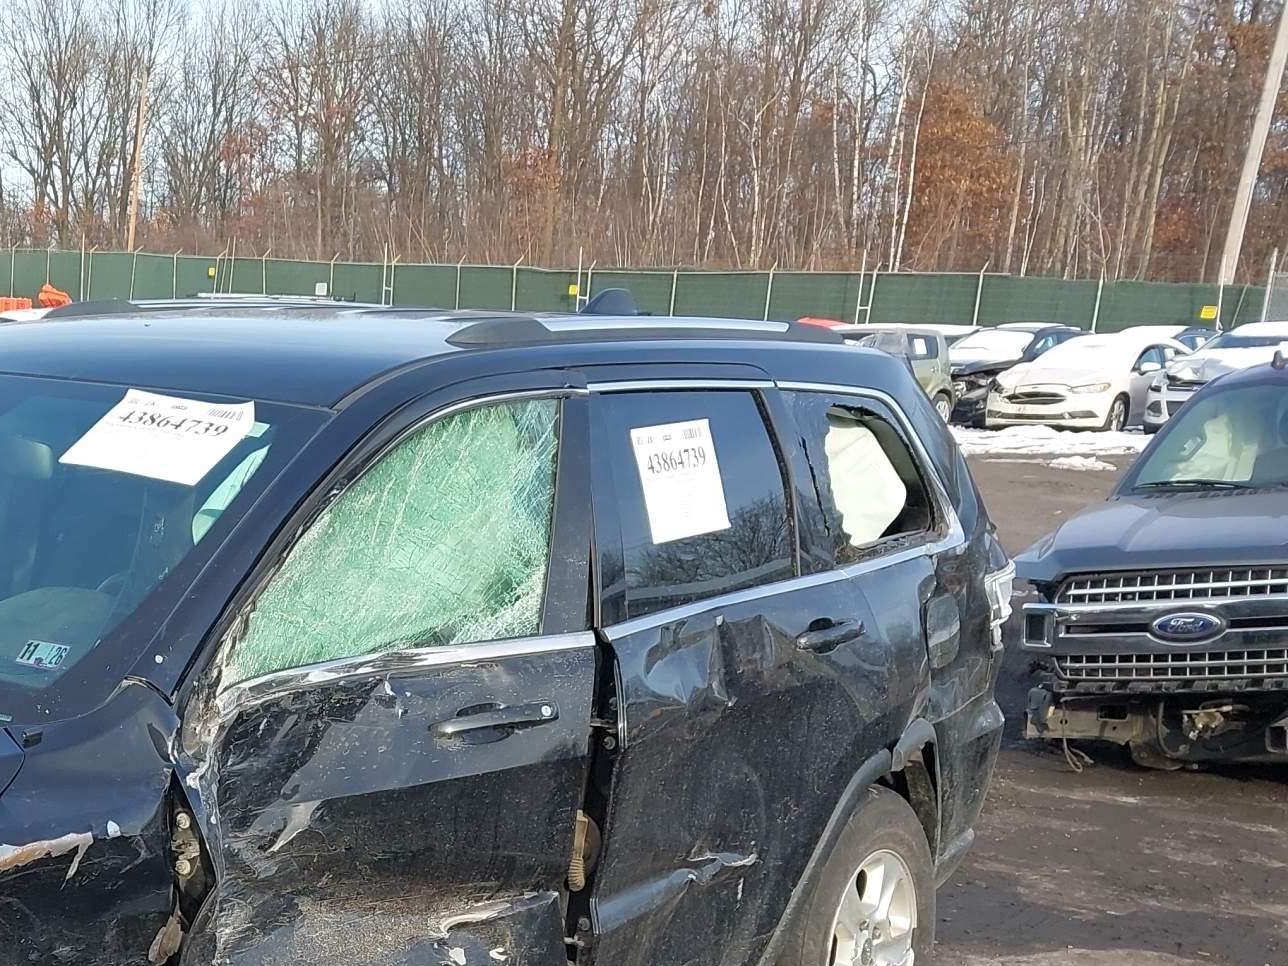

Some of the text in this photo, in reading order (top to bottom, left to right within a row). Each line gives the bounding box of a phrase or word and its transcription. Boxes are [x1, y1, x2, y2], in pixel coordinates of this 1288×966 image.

[119, 410, 229, 437] 43864739
[647, 446, 706, 474] 43864739
[1167, 617, 1204, 633] Ford
[20, 641, 68, 665] 11 26
